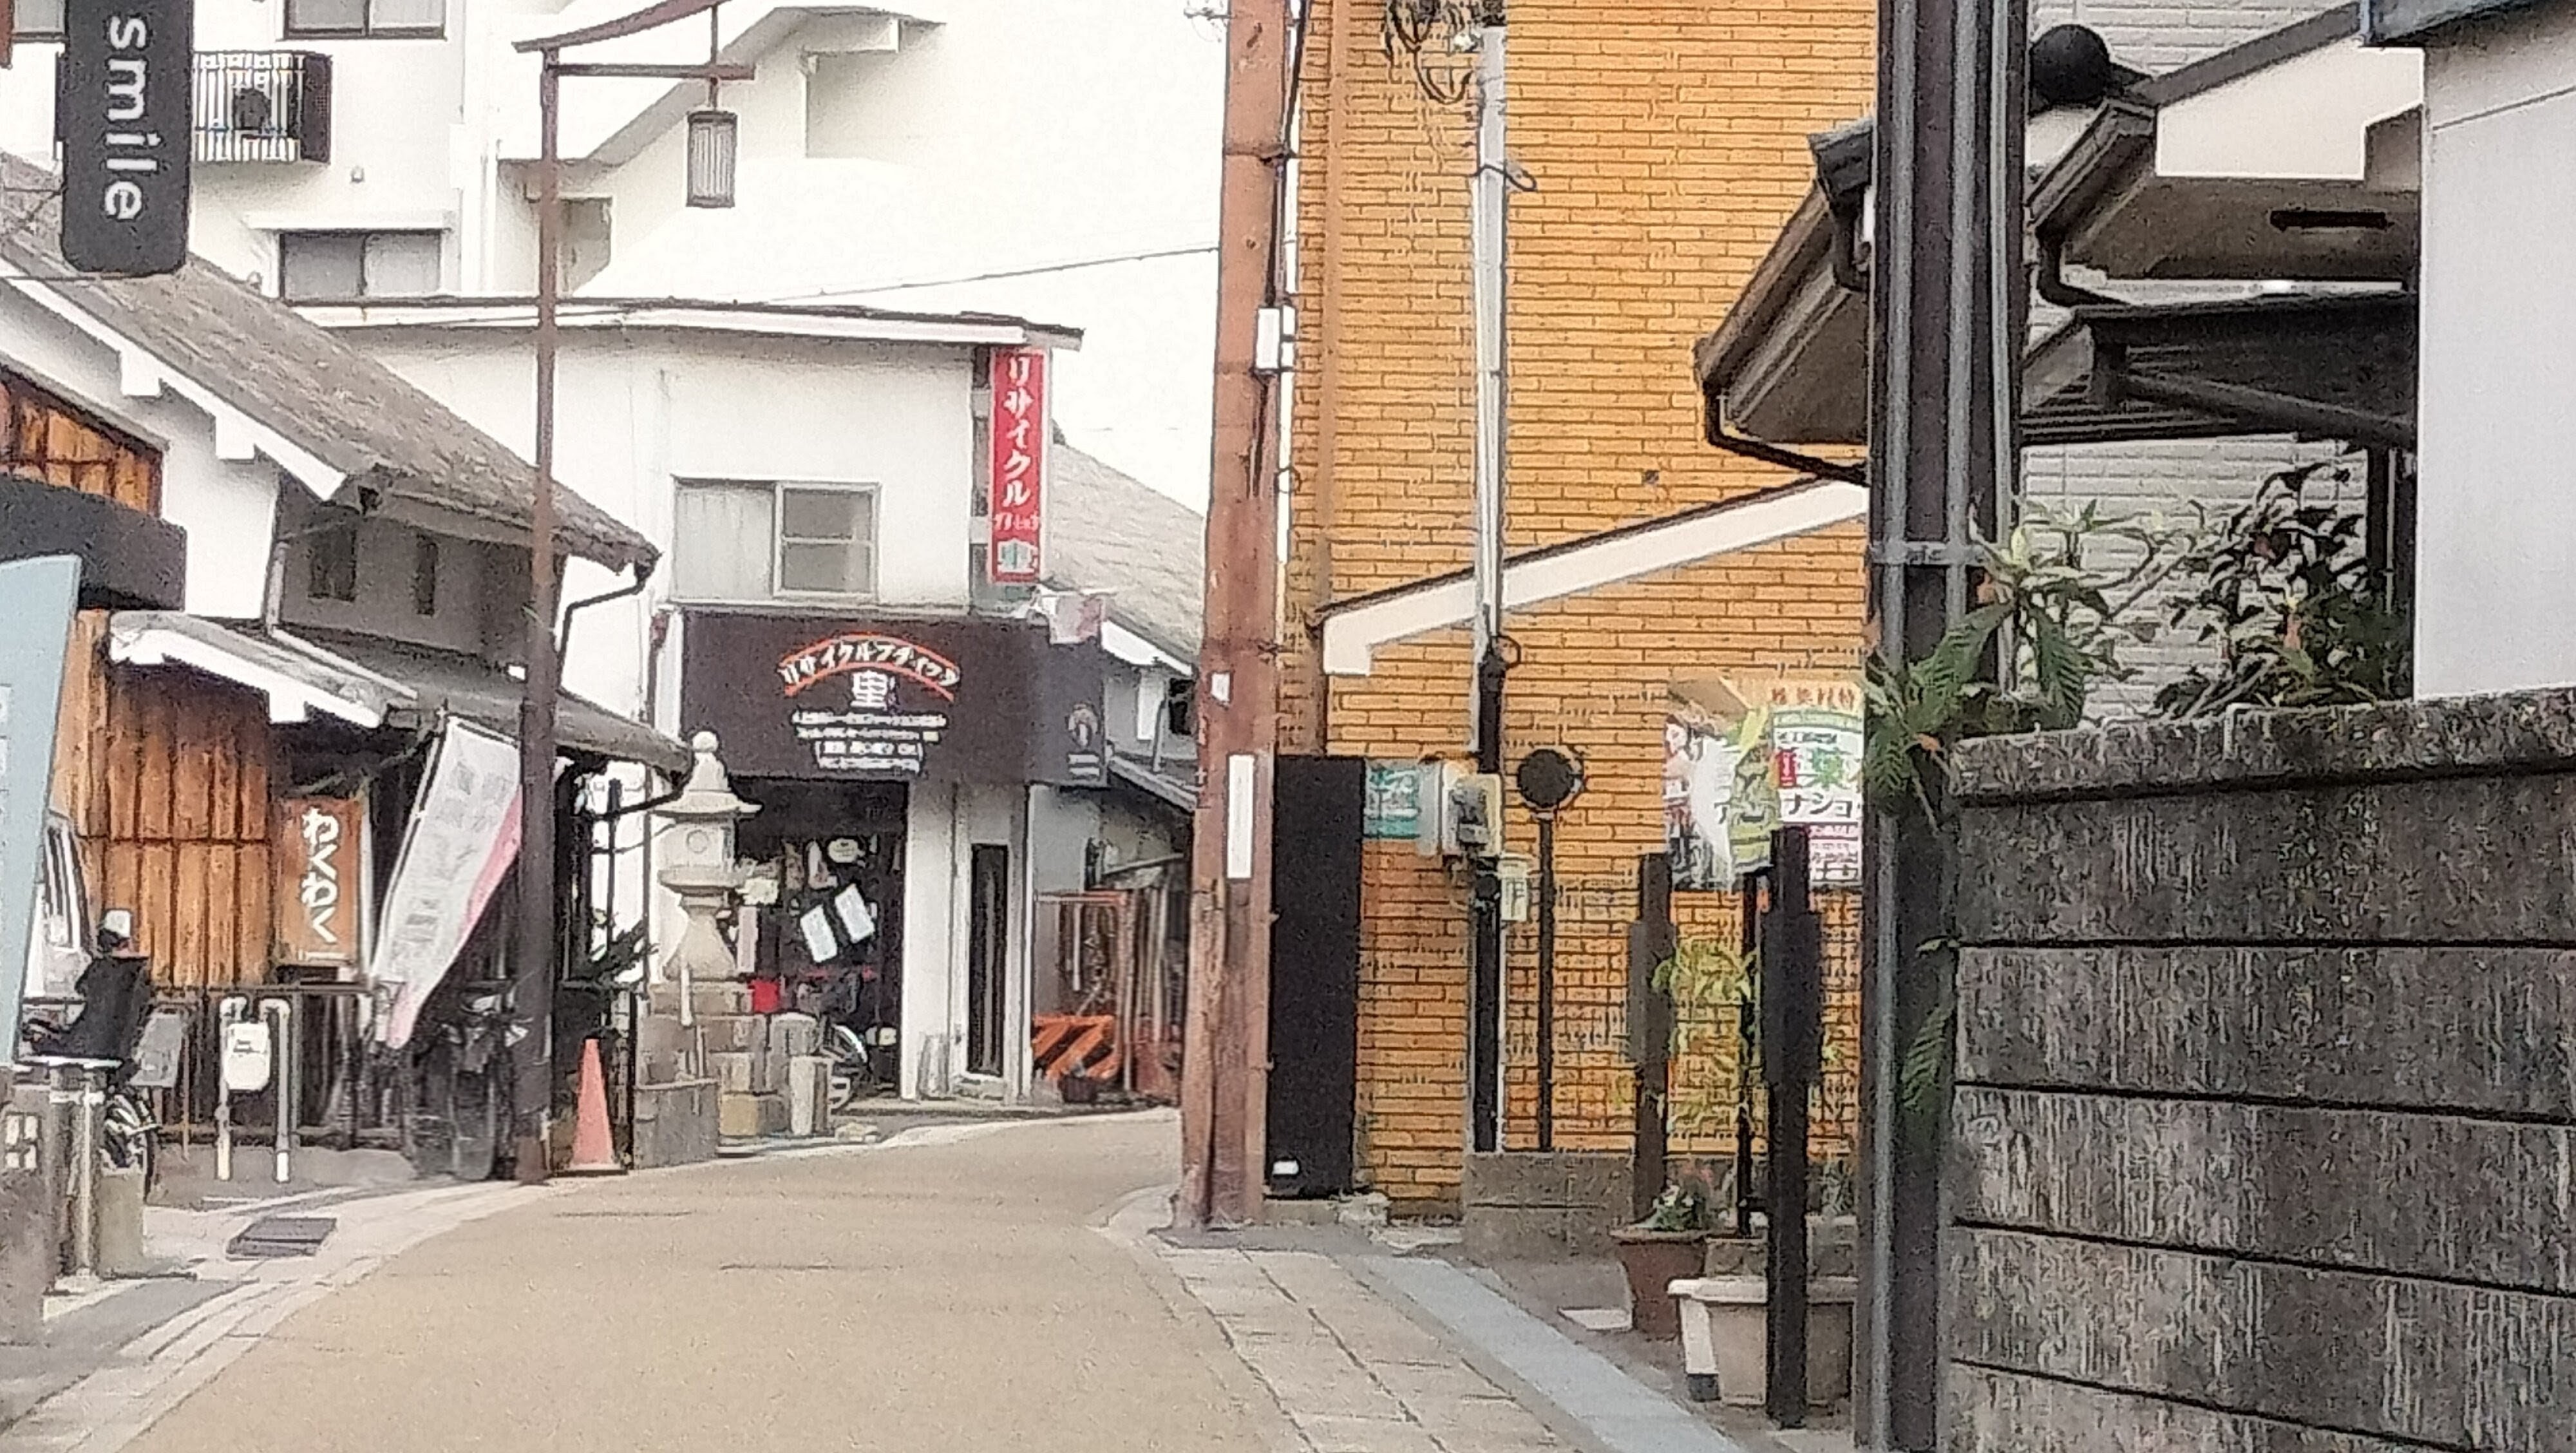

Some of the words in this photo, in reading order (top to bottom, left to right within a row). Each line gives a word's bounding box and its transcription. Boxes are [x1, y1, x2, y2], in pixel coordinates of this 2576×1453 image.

[105, 16, 162, 220] smile
[1003, 357, 1033, 508] リサイクル
[301, 807, 339, 943] わくわく
